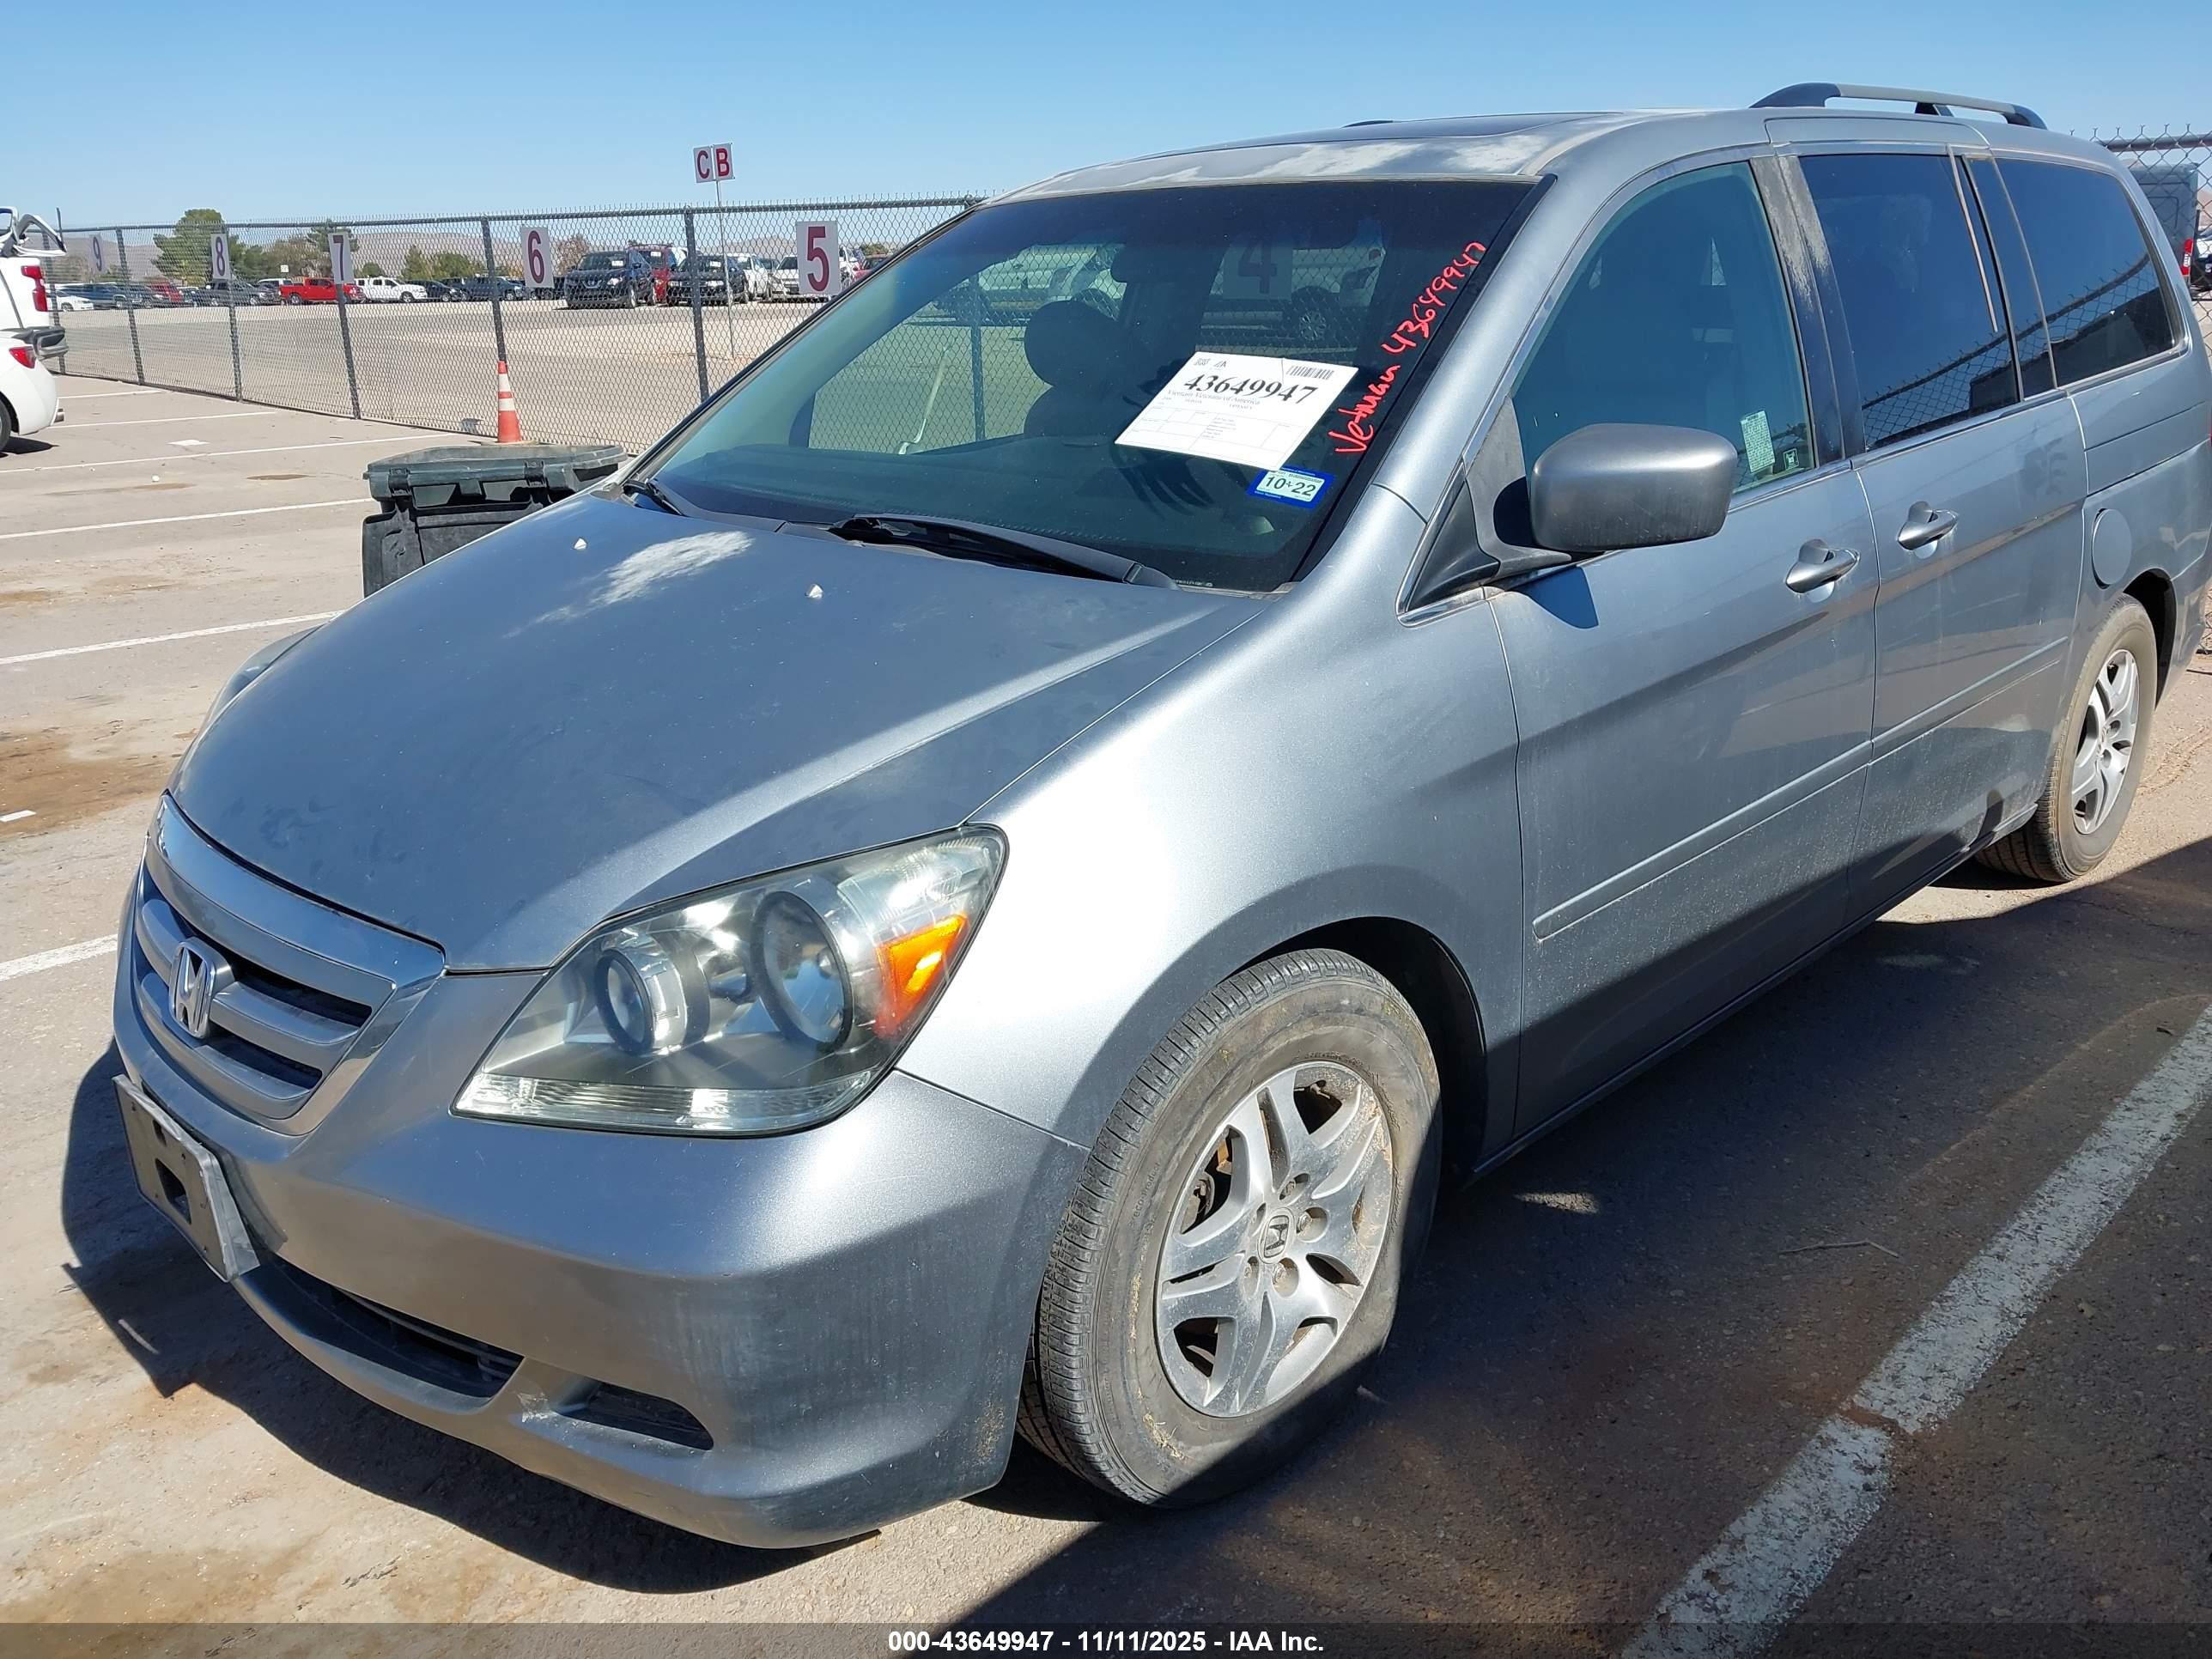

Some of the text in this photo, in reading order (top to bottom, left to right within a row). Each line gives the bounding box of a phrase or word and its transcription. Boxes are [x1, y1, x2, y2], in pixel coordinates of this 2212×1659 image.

[696, 147, 730, 179] C B
[92, 235, 102, 272] 9
[215, 235, 226, 276] 8
[332, 234, 344, 281] 7
[526, 230, 545, 284] 6
[806, 225, 830, 292] 5
[1237, 235, 1278, 294] 4
[1381, 241, 1486, 354] 43649947
[1183, 374, 1319, 404] 43649947
[1266, 476, 1286, 489] 10
[1291, 482, 1316, 496] 22
